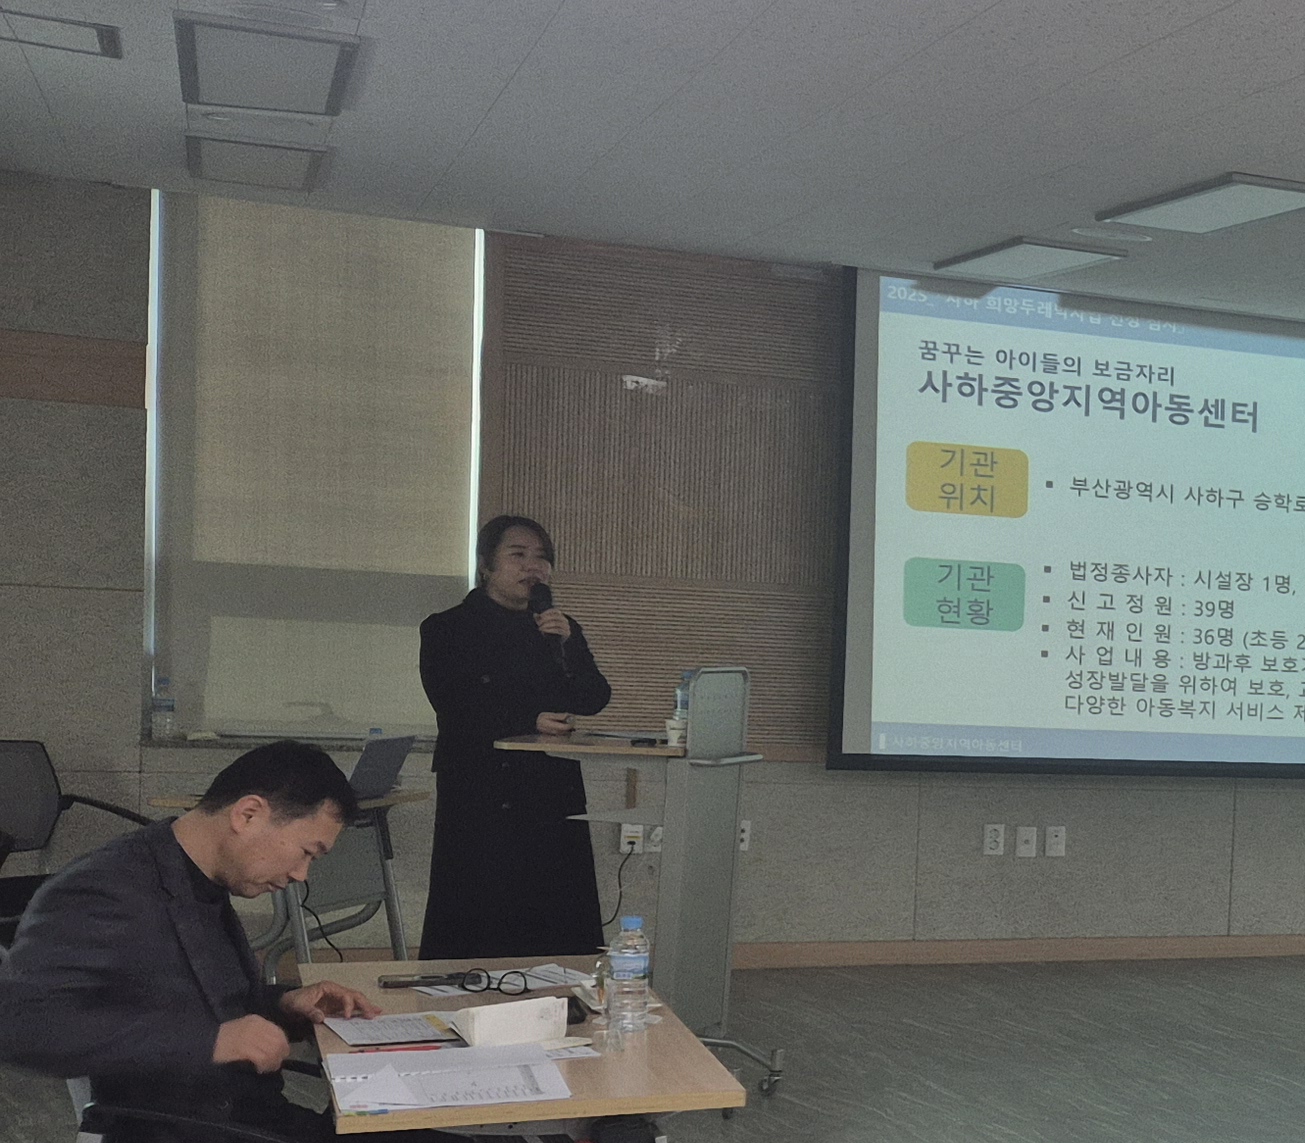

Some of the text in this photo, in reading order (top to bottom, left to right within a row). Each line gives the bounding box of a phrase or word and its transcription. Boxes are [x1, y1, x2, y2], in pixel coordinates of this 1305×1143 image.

[918, 339, 1176, 387] 꿈꾸는 아이들의 보금자리
[917, 369, 1259, 434] 사하중앙지역아동센터
[939, 447, 999, 479] 기관
[938, 482, 996, 513] 위치
[1069, 476, 1174, 505] 부산광역시
[1184, 485, 1245, 509] 사하구
[937, 563, 995, 593] 기관
[1070, 560, 1174, 588] 법정종사자
[1193, 569, 1254, 592] 시설장
[1262, 574, 1297, 597] 1명,
[936, 596, 994, 626] 현황
[1067, 590, 1087, 612] 신
[1096, 593, 1117, 612] 고
[1125, 594, 1144, 615] 정
[1154, 595, 1172, 617] 원
[1193, 599, 1235, 620] 39명
[1066, 618, 1086, 640] 현
[1096, 620, 1115, 642] 재
[1125, 622, 1143, 643] 인
[1153, 623, 1171, 645] 원
[1192, 627, 1234, 648] 36명
[1242, 629, 1290, 650] (초등
[1065, 645, 1086, 666] 사
[1096, 645, 1114, 666] 업
[1124, 647, 1143, 669] 내
[1152, 649, 1172, 669] 용
[1192, 651, 1252, 674] 방과후
[1064, 669, 1170, 694] 성장발달을
[1178, 674, 1238, 697] 위하여
[1246, 679, 1291, 701] 보호,
[1064, 694, 1127, 717] 다양한
[1135, 697, 1217, 720] 아동복지
[1226, 701, 1285, 722] 서비스
